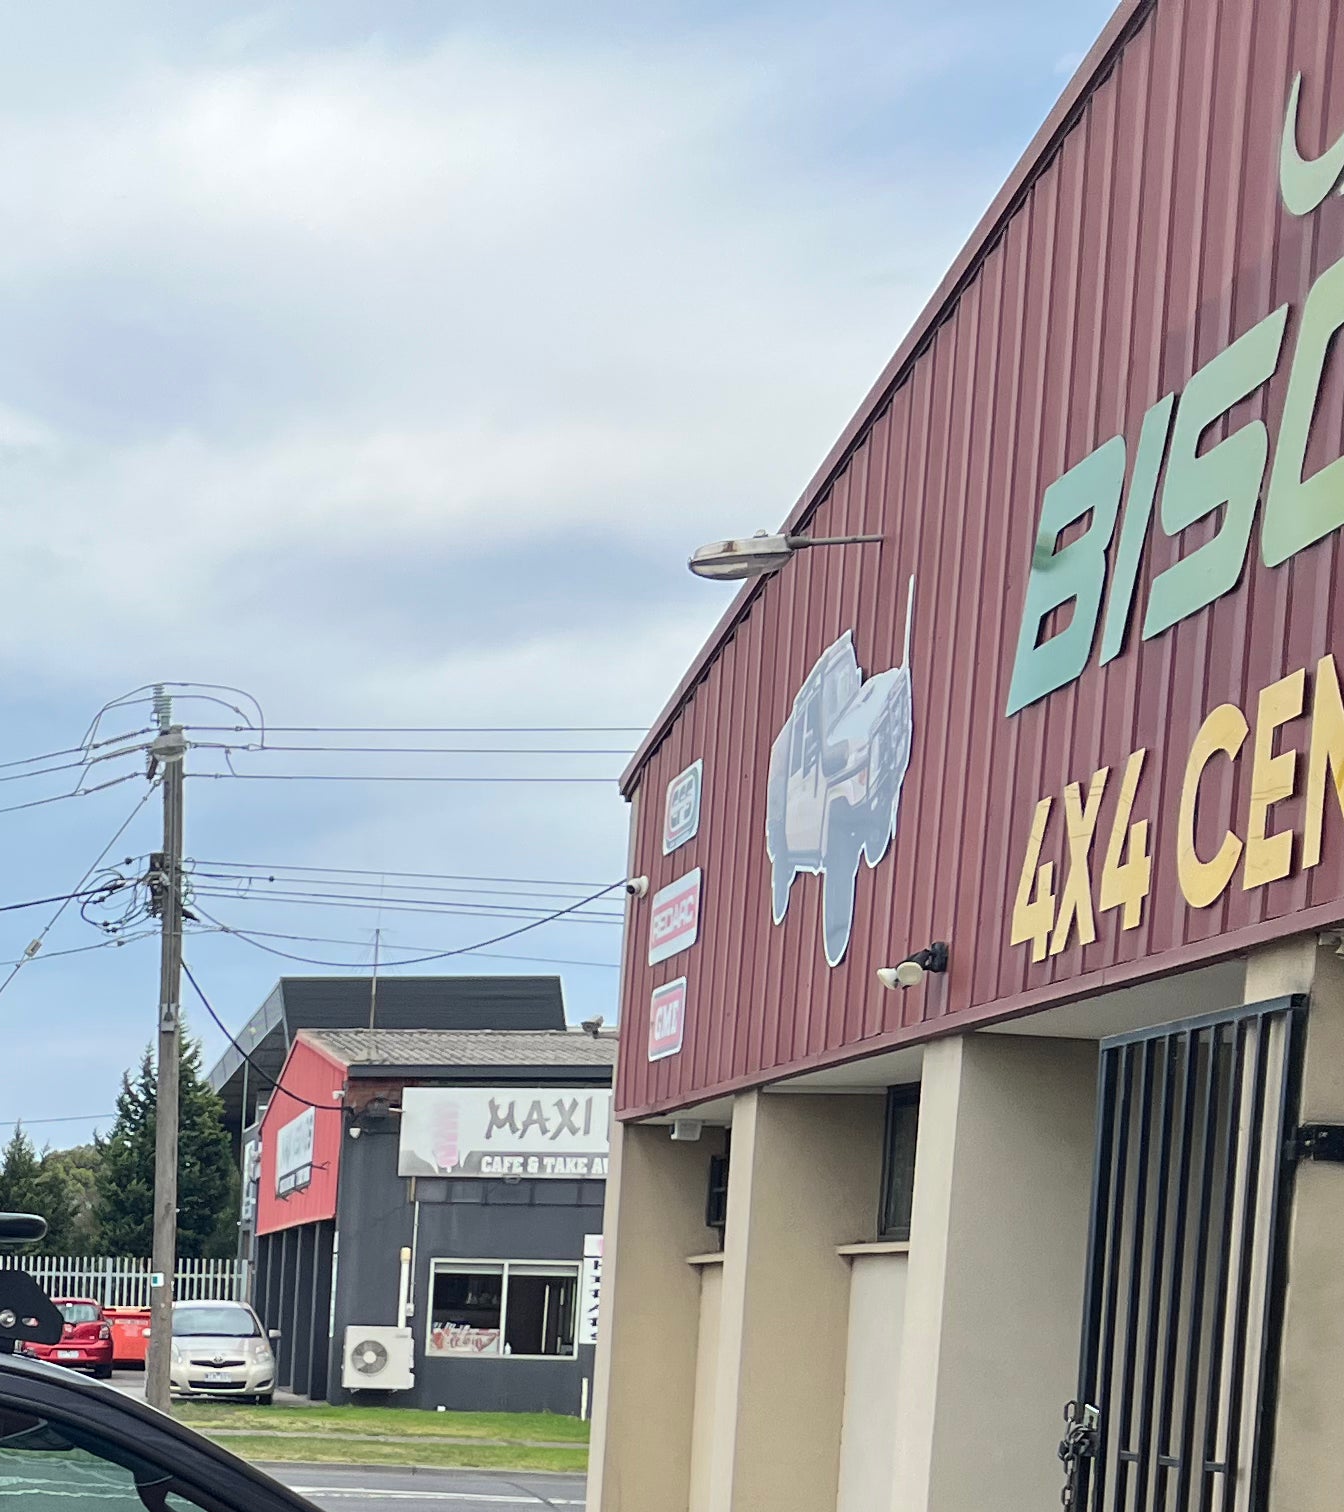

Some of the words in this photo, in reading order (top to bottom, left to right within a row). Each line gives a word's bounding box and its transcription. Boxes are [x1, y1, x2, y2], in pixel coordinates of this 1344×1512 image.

[1009, 747, 1153, 962] 4X4
[653, 895, 695, 940] REDARC
[484, 1096, 593, 1140] MAXI
[480, 1155, 524, 1174] CAFE
[526, 1156, 540, 1173] &
[543, 1156, 587, 1174] TAKE
